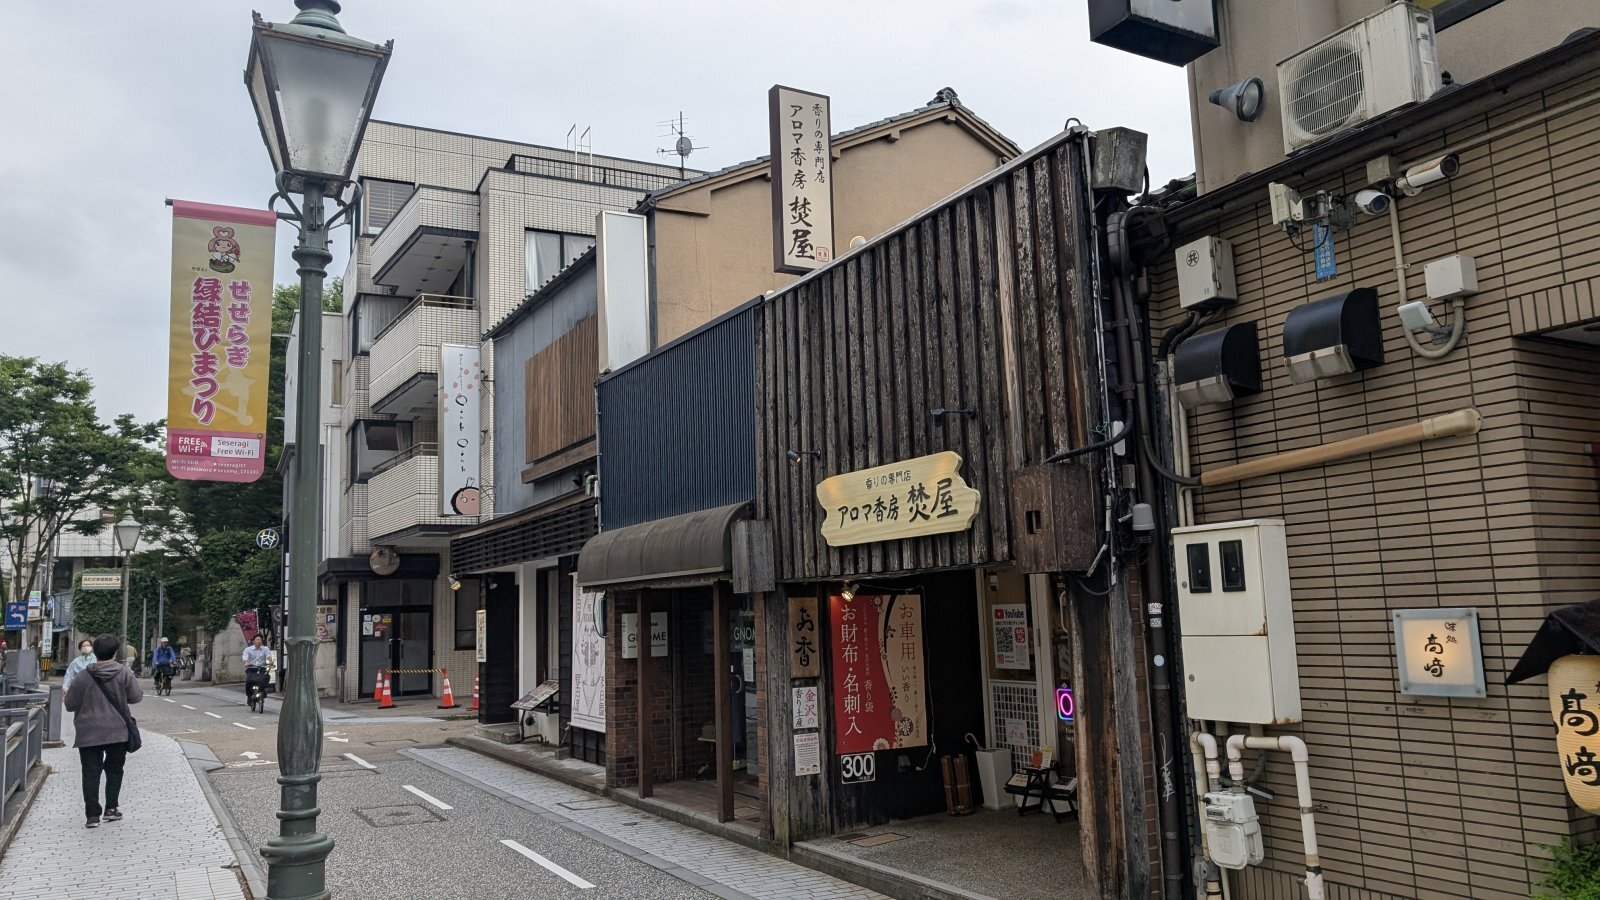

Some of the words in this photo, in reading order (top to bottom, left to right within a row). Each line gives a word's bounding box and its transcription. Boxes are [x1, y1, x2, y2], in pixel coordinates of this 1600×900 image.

[789, 104, 807, 190] アロマ香房
[812, 103, 825, 184] 香りの専門店
[788, 196, 816, 260] 焚屋
[227, 279, 251, 369] せせらぎ
[191, 276, 223, 426] 縁結びまつり
[178, 437, 201, 446] FREE
[178, 445, 203, 454] Wi-Fi
[217, 439, 249, 448] Seseragi
[865, 470, 911, 490] 香りの専門店
[838, 494, 900, 528] アロマ香房
[906, 477, 958, 522] 焚屋
[327, 615, 334, 623] P
[899, 604, 915, 661] お車用
[1004, 608, 1025, 619] YouTube
[628, 632, 666, 643] GME
[795, 606, 816, 667] お香
[840, 604, 863, 736] お財布・名刺入
[901, 665, 911, 703] いい香り
[793, 688, 804, 728] 香り土産
[804, 688, 817, 725] 金沢の
[863, 680, 874, 713] 香り袋
[842, 754, 874, 778] 300
